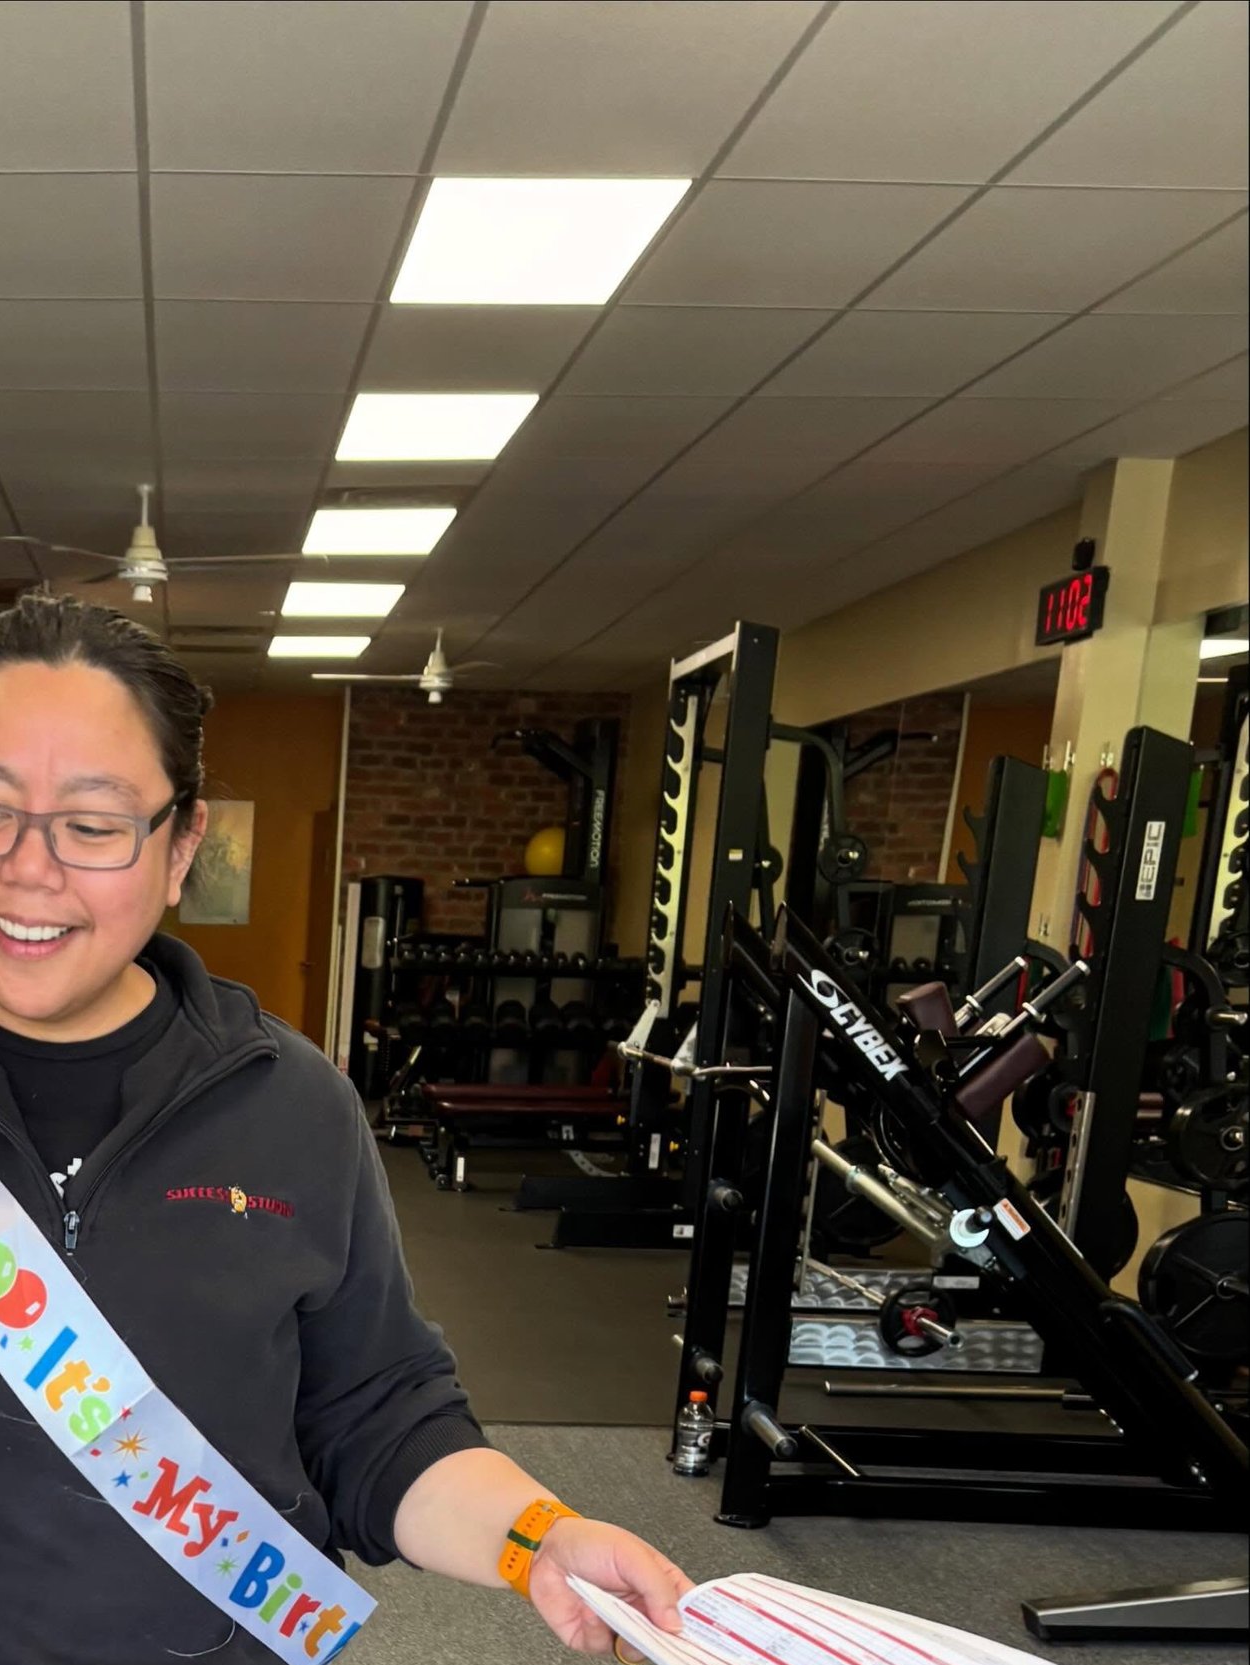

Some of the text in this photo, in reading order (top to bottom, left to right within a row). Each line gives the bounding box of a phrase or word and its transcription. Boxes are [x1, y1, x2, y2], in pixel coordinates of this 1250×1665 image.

[829, 1000, 910, 1082] CYBEX
[24, 1325, 112, 1445] It's
[132, 1456, 239, 1560] My
